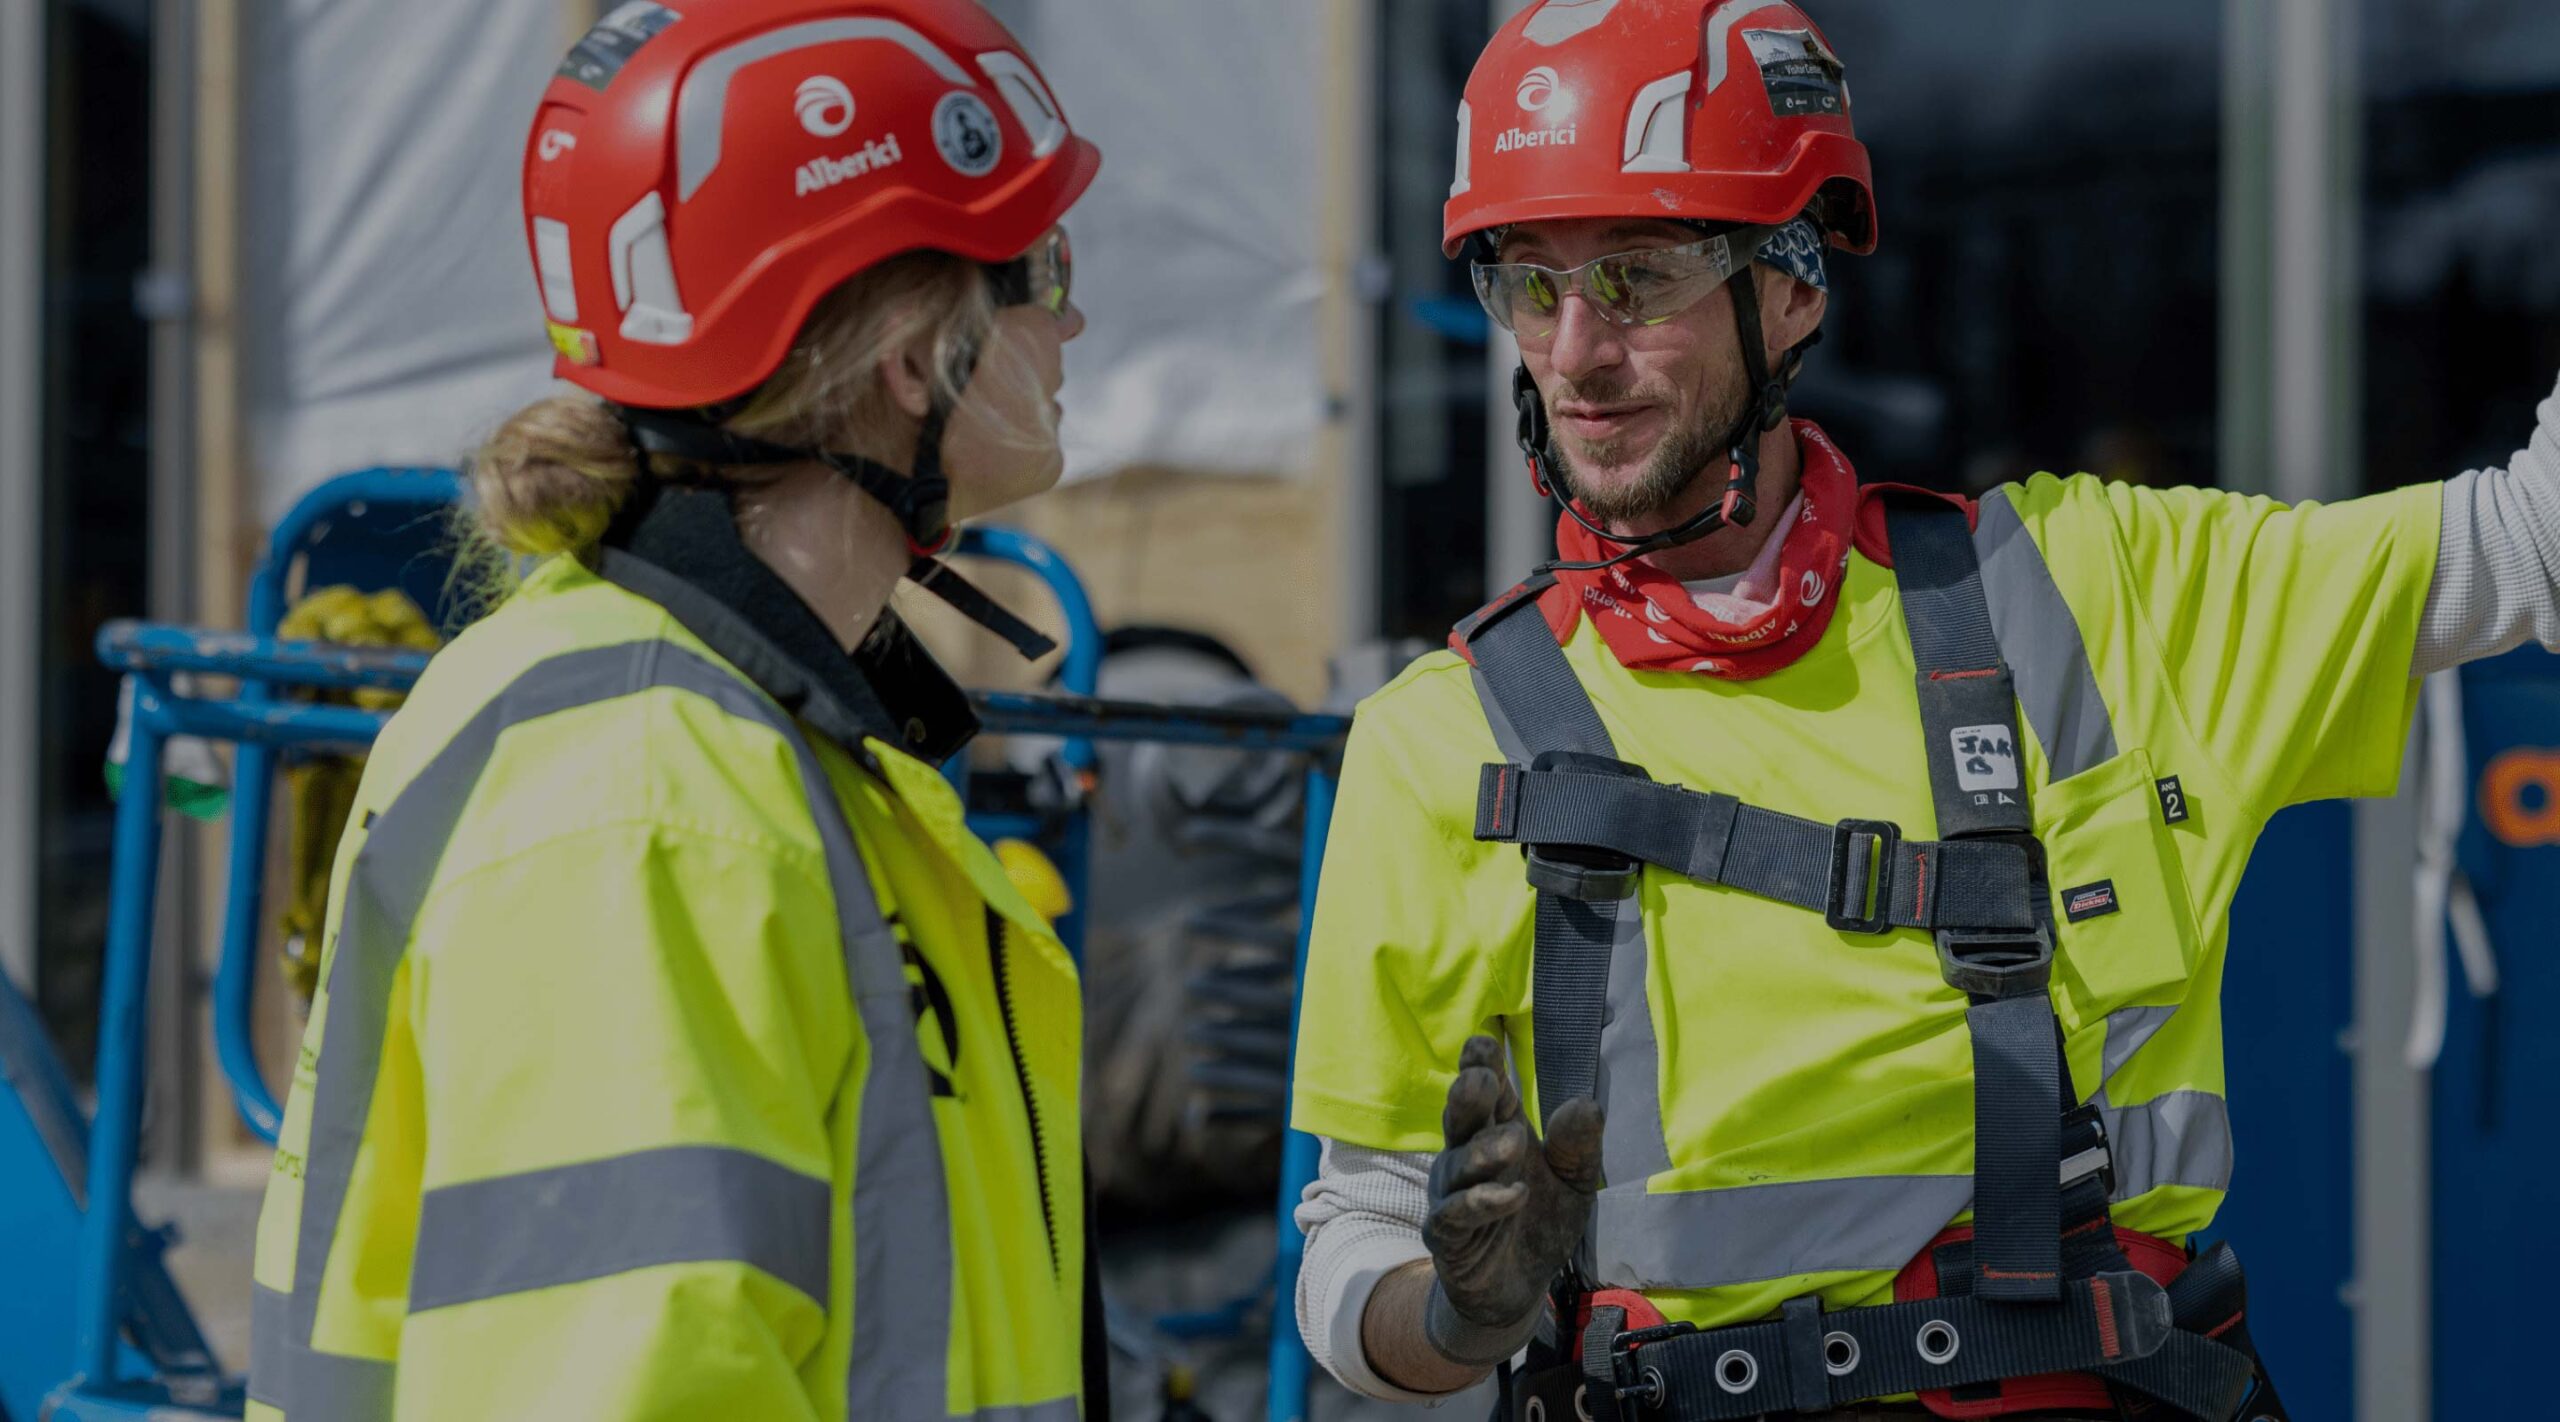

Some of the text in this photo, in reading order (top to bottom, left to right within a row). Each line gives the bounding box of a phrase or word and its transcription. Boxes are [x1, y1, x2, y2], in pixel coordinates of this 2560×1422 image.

[1493, 123, 1577, 154] Alberici
[795, 132, 903, 197] Alberici
[2160, 781, 2177, 793] ANSI
[2166, 793, 2182, 818] 2
